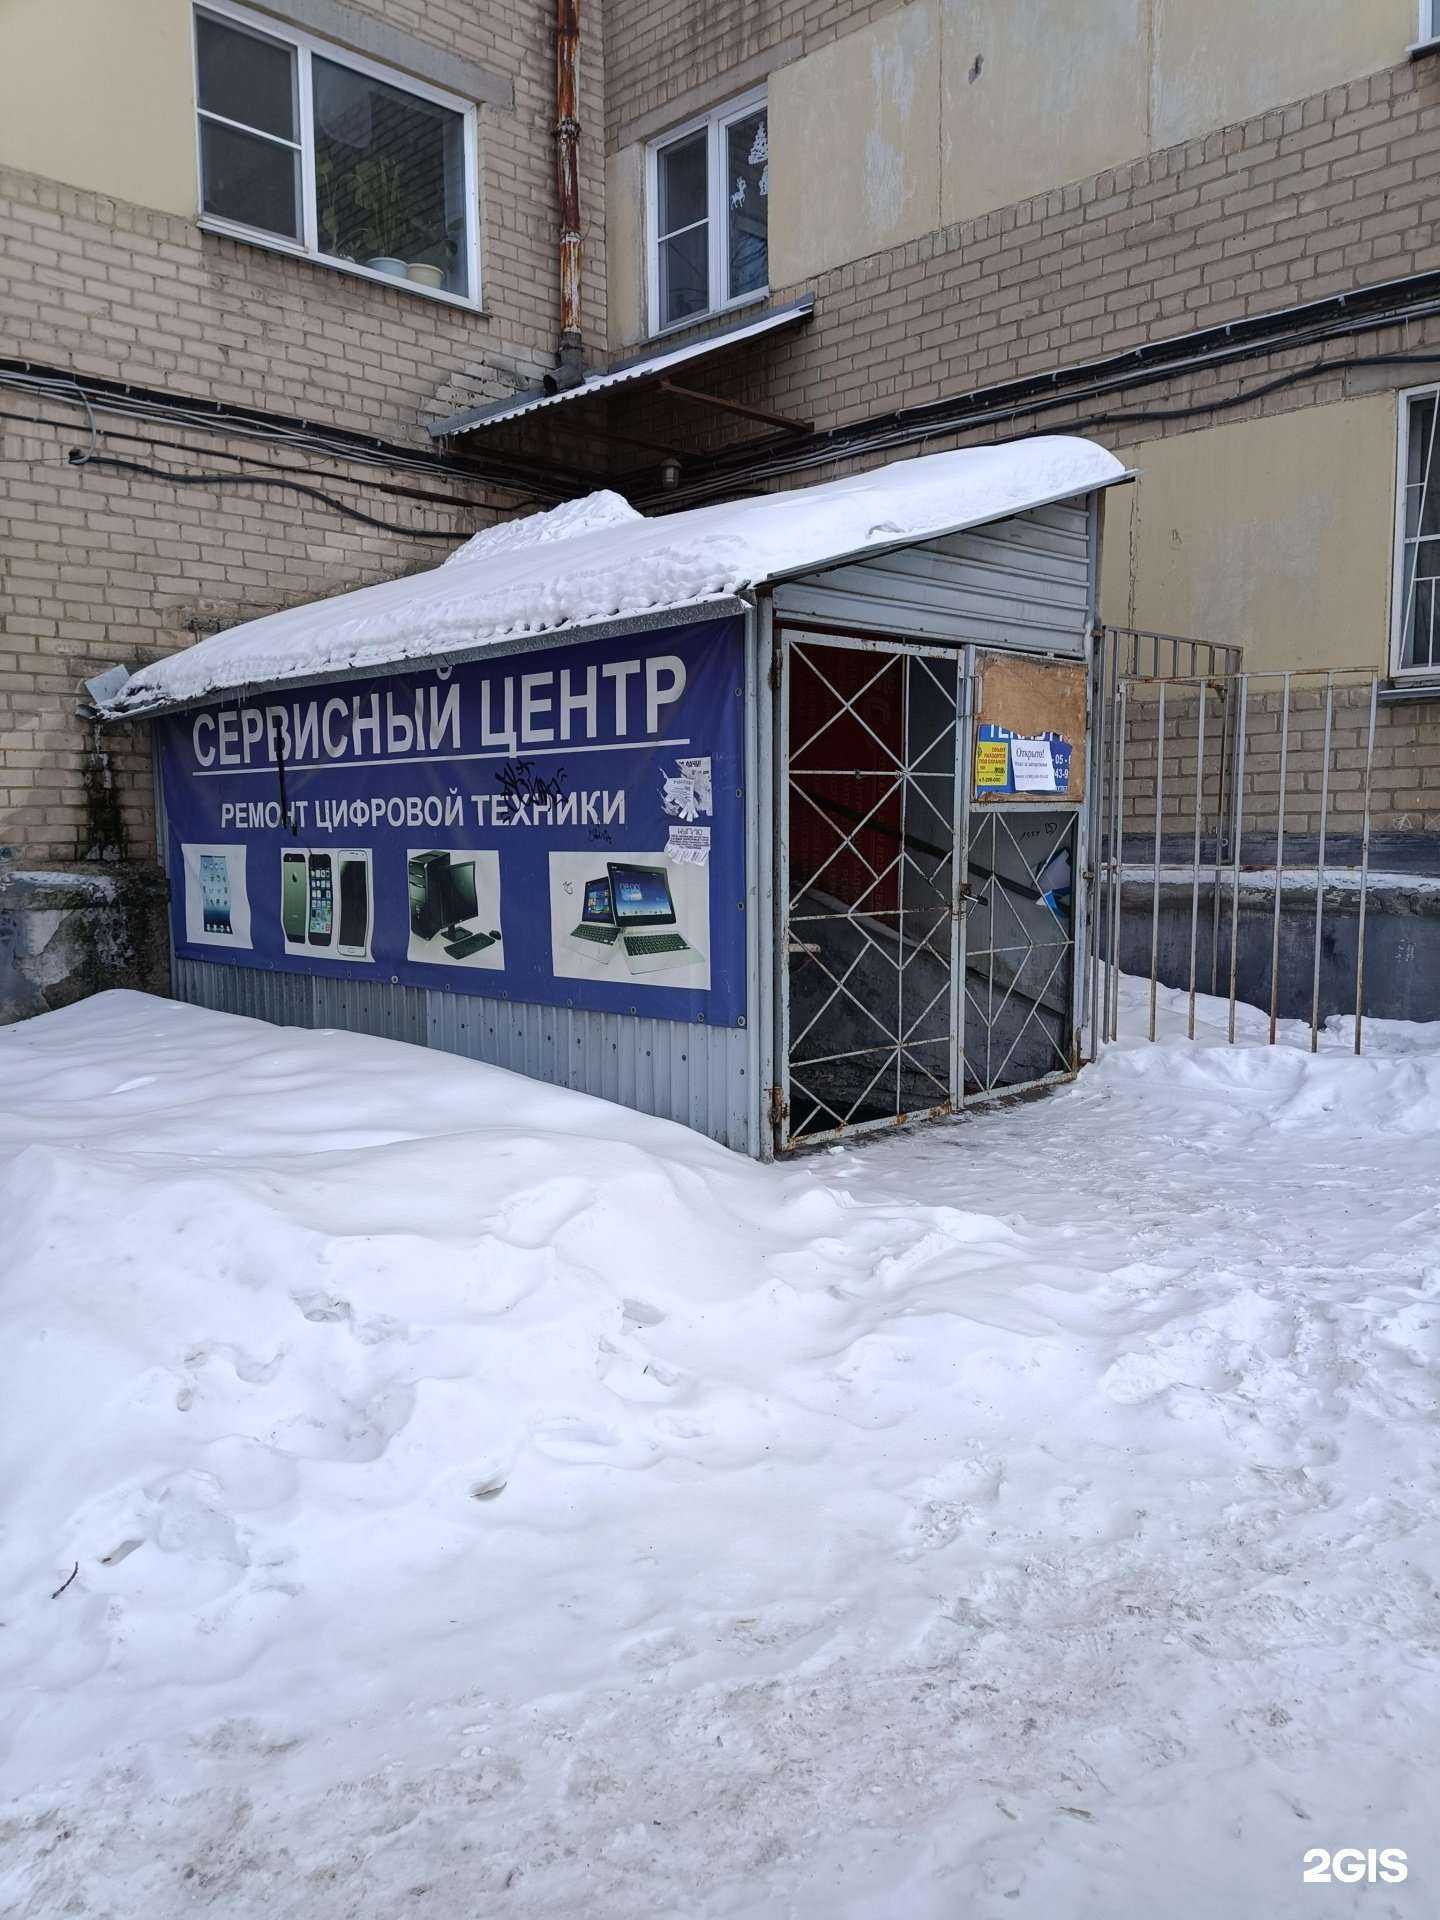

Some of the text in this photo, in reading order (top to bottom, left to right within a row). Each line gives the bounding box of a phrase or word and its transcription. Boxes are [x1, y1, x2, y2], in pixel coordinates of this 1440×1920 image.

[192, 655, 687, 767] СЕРВИСНЫЙ ЦЕНТР
[315, 787, 464, 832] ЦИФРОВОЙ
[471, 789, 626, 826] ТЕХНИКИ
